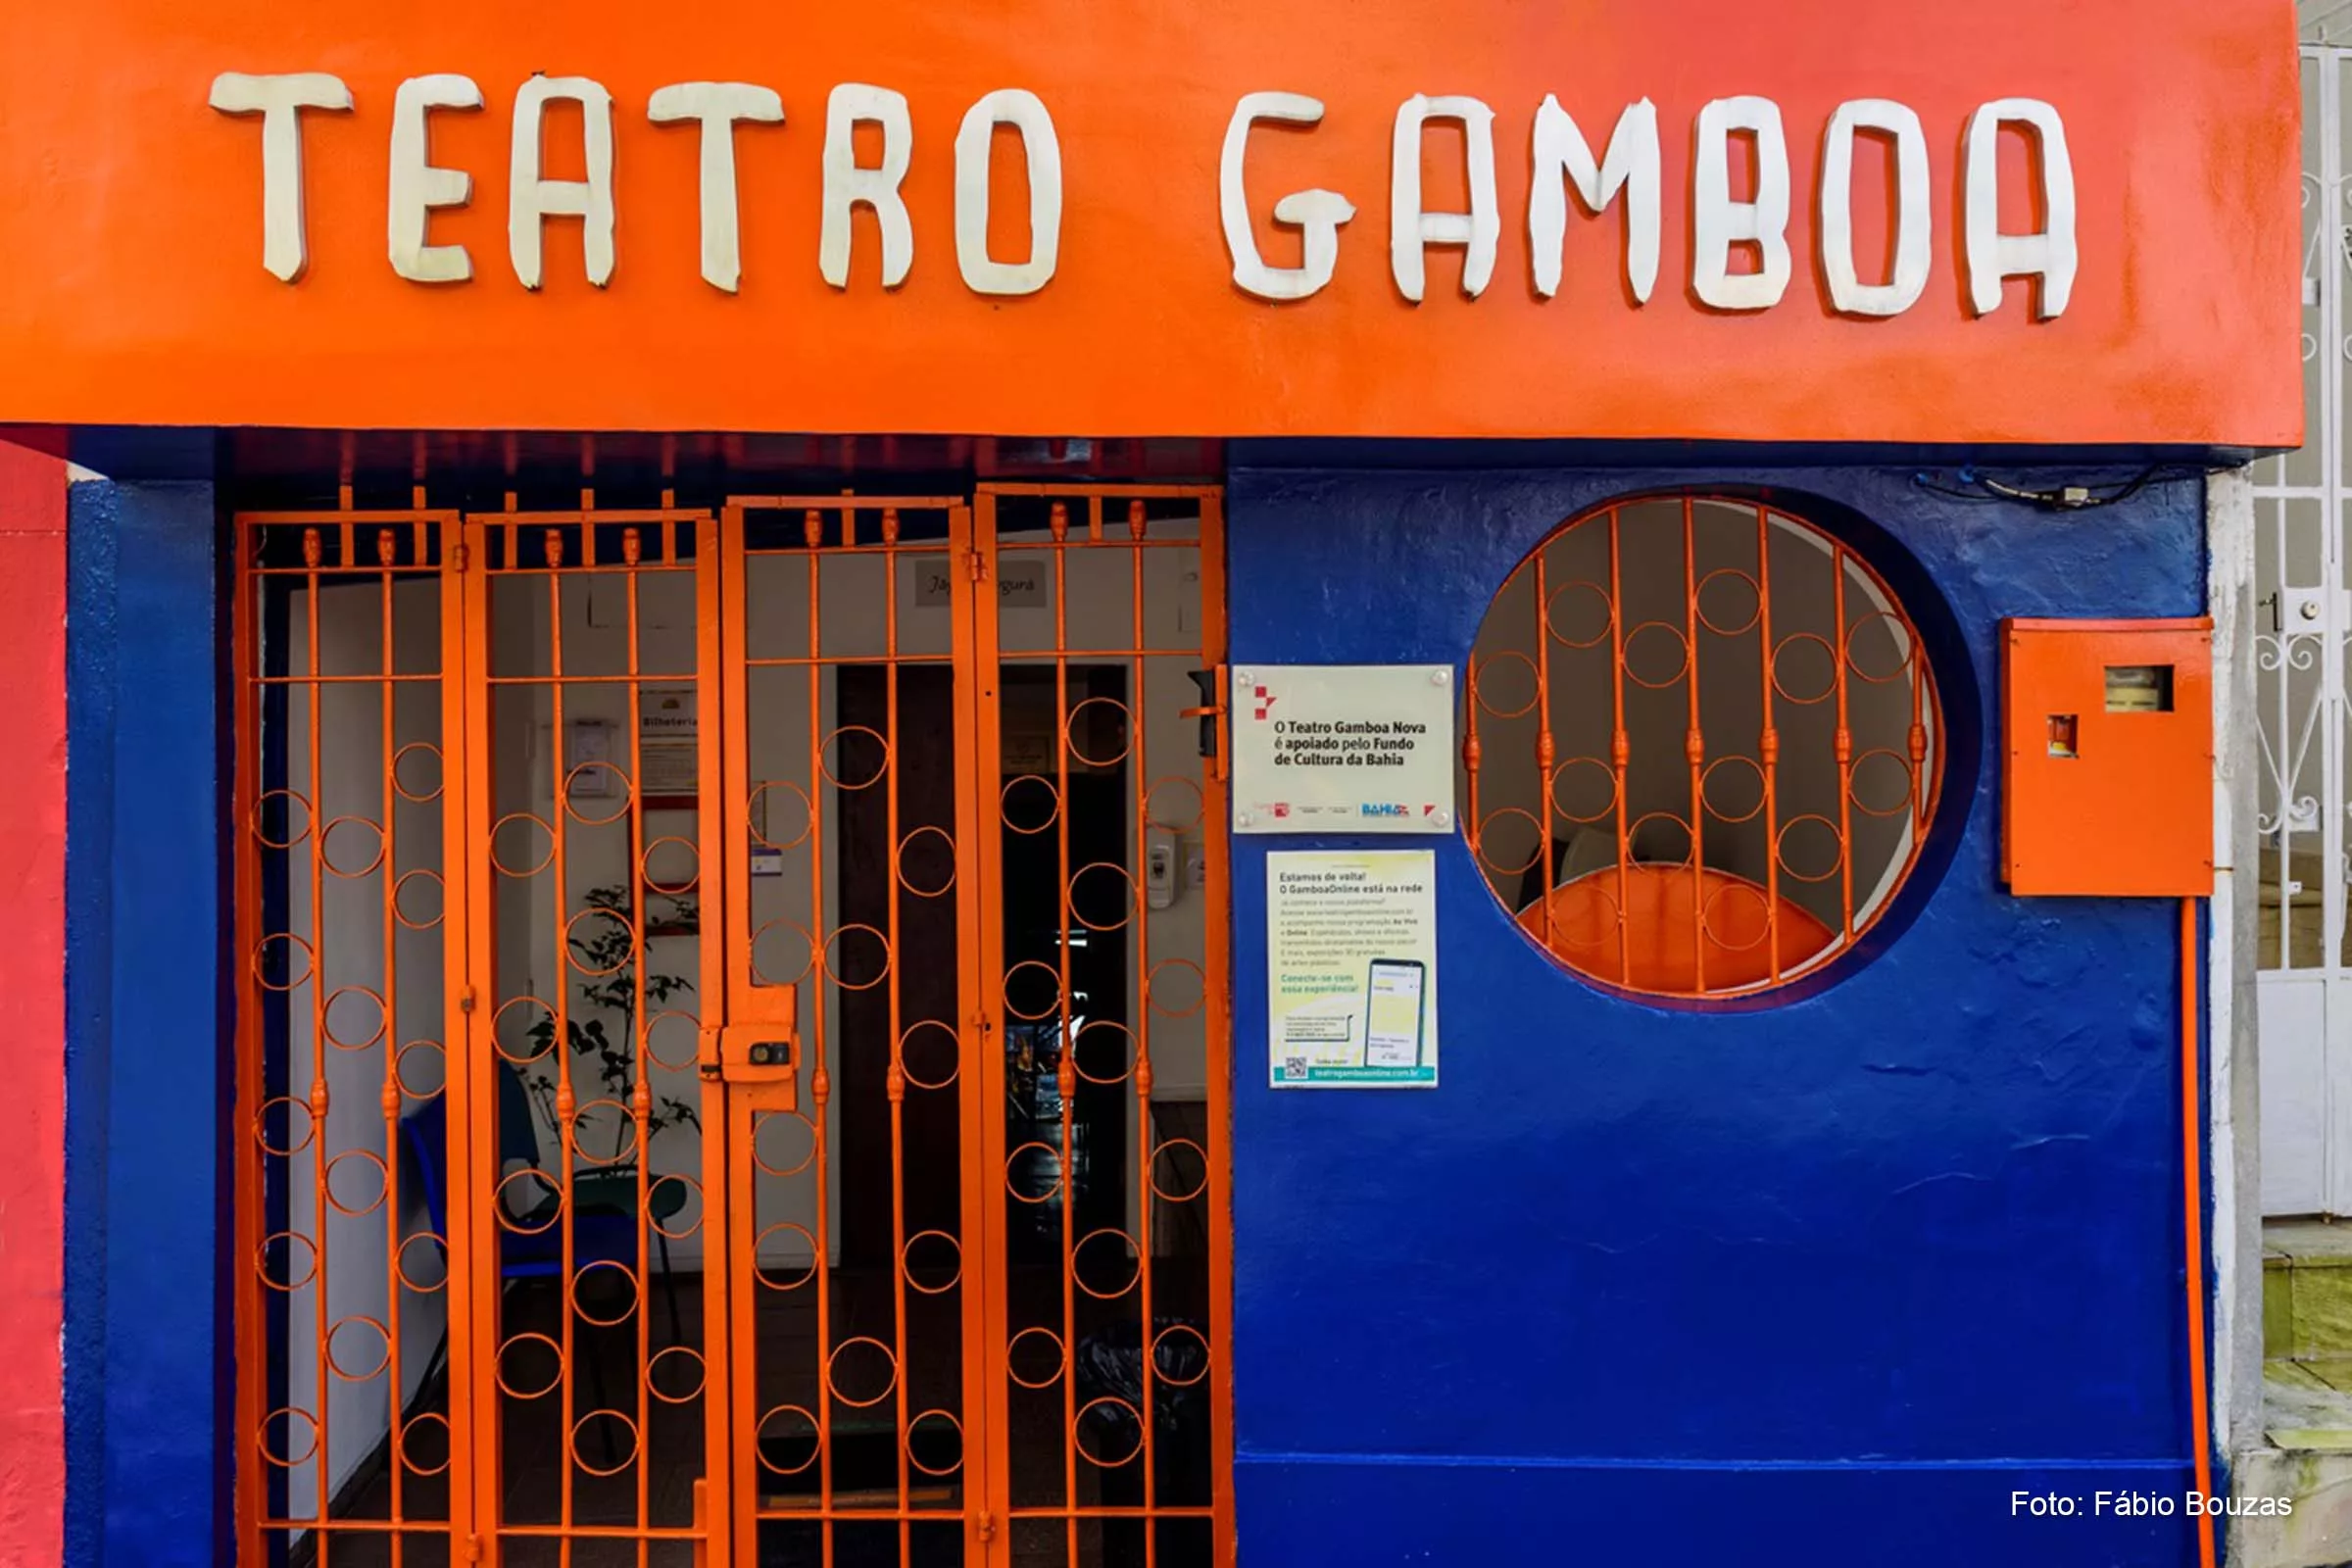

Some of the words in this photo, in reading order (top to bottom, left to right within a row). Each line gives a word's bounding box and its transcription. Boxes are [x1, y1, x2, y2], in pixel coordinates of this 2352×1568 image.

[209, 72, 1061, 295] TEATRO
[1219, 91, 2078, 319] GAMBOA
[1274, 721, 1285, 734] O
[1289, 721, 1332, 734] Teatro
[1334, 721, 1390, 734] Gamboa
[1393, 722, 1427, 734] Nova
[1274, 737, 1283, 750] é
[1286, 737, 1339, 753] apoiado
[1342, 737, 1371, 753] pelo
[1373, 738, 1414, 751] Fundo
[1274, 753, 1291, 765] de
[1294, 753, 1344, 765] Cultura
[1347, 754, 1363, 765] da
[1366, 754, 1404, 765] Bahia
[1279, 872, 1322, 882] Estamos
[1324, 872, 1337, 882] de
[1339, 871, 1366, 881] volta!
[1279, 885, 1287, 894] O
[1289, 884, 1360, 894] GamboaOnline
[1362, 883, 1384, 894] está
[1400, 884, 1423, 893] rede
[1281, 973, 1332, 983] Conecte-se
[1281, 985, 1302, 994] essa
